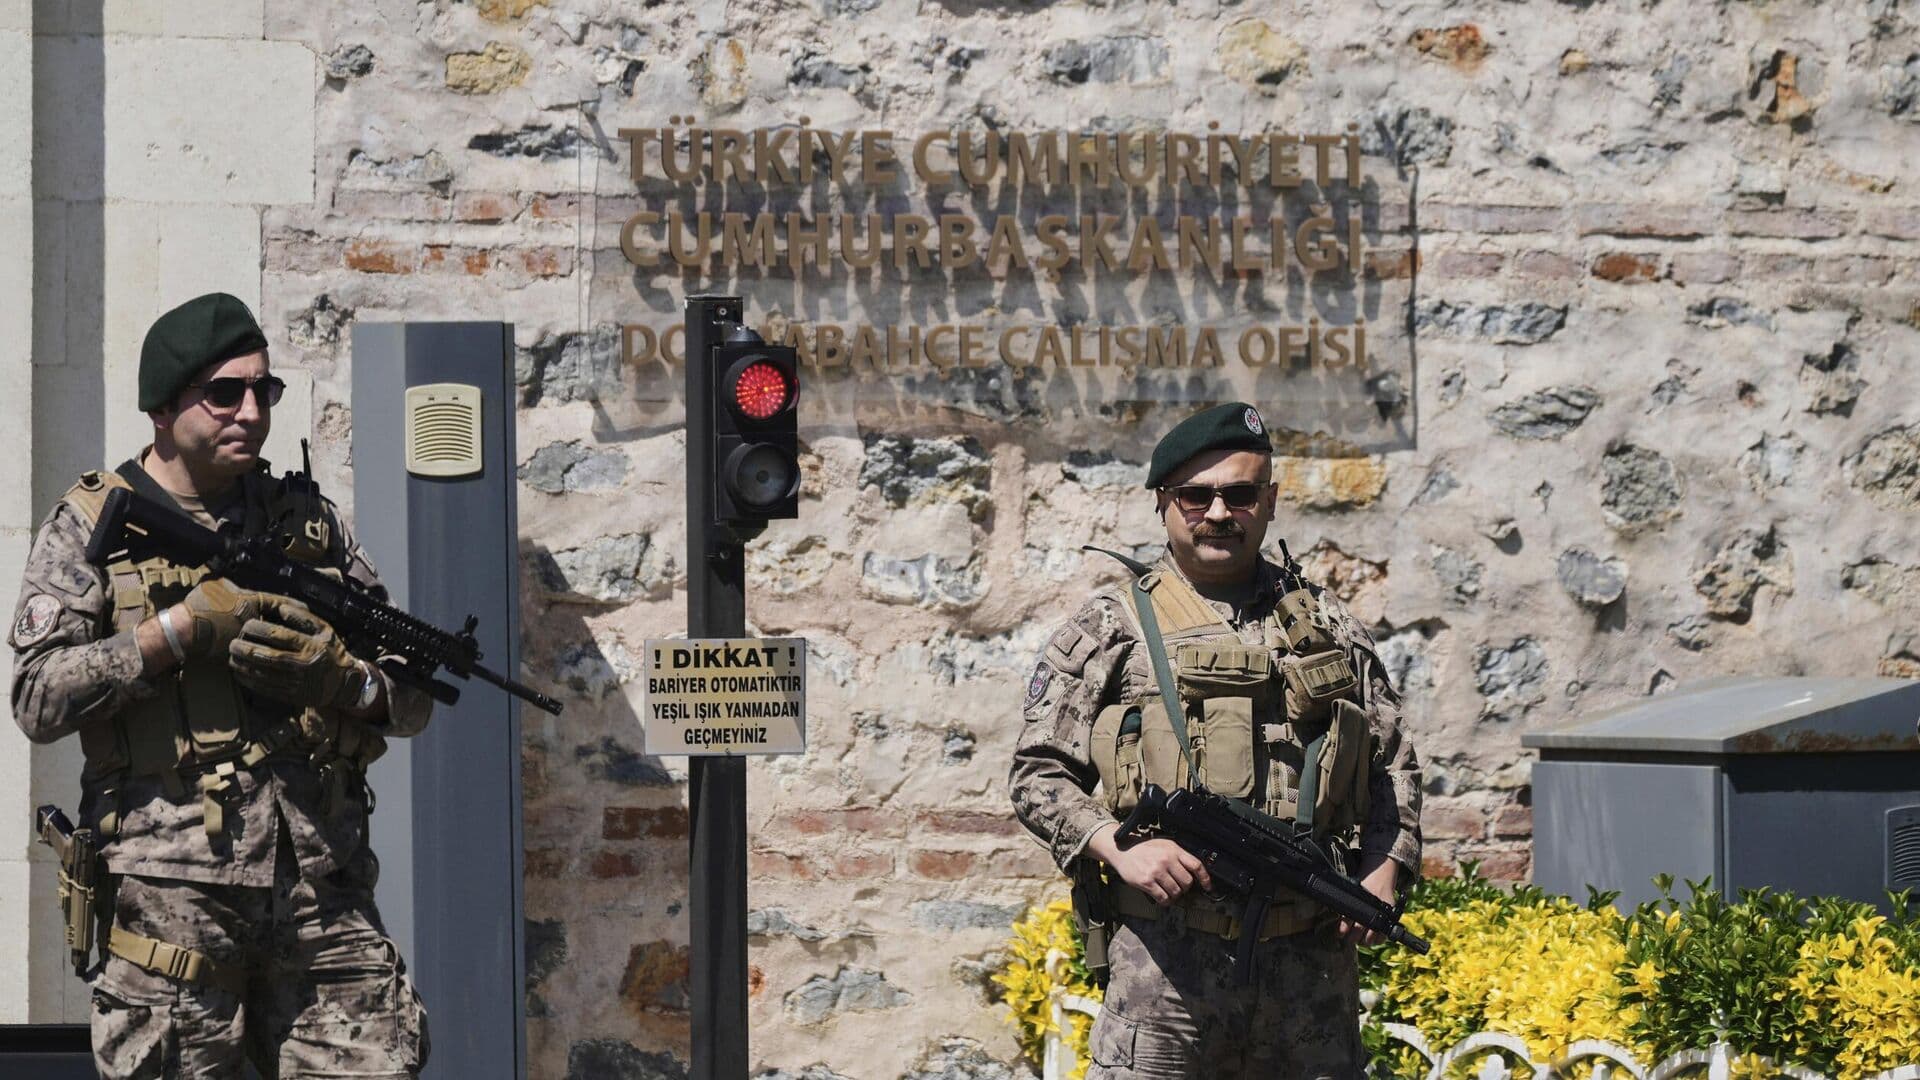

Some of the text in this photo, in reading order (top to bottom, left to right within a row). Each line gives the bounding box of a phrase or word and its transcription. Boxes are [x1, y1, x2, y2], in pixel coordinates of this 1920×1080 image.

[618, 115, 1361, 188] TÜRKİYE CUMHURİYETİ
[619, 204, 1361, 283] CUMHURBAŞKANLIĞI
[621, 317, 1367, 380] DOABAHÇE ÇALIŞMA OFİSİ
[654, 643, 796, 669] ! DİKKAT !
[649, 671, 801, 694] BARİYER OTOMATİKTİR
[652, 698, 799, 724] YEŞİL IŞIK YANMADAN
[684, 723, 767, 749] GEÇMEYİNİZ
